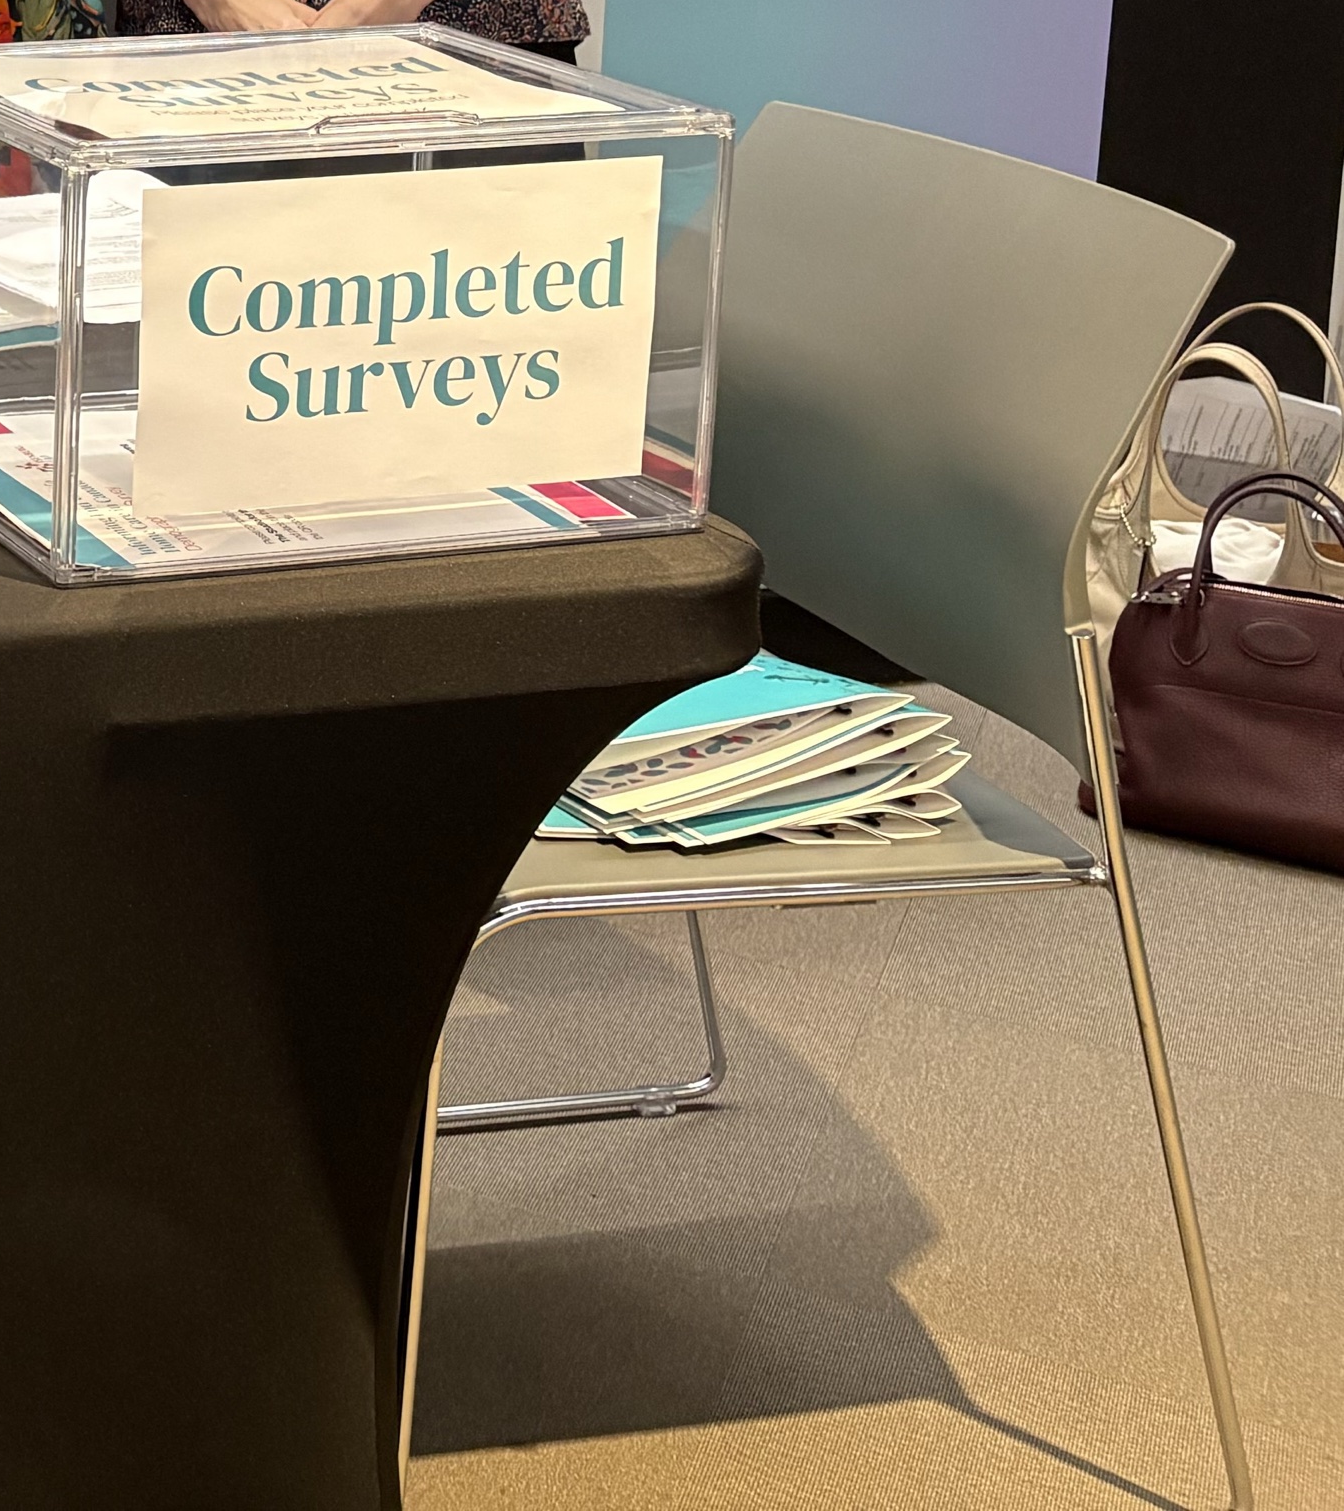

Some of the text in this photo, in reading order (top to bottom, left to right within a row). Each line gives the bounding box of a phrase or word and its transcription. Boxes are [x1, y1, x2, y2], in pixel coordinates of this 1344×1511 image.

[24, 56, 450, 95] Completed
[118, 80, 439, 109] Surveys
[188, 236, 624, 346] Completed
[245, 349, 561, 426] Surveys
